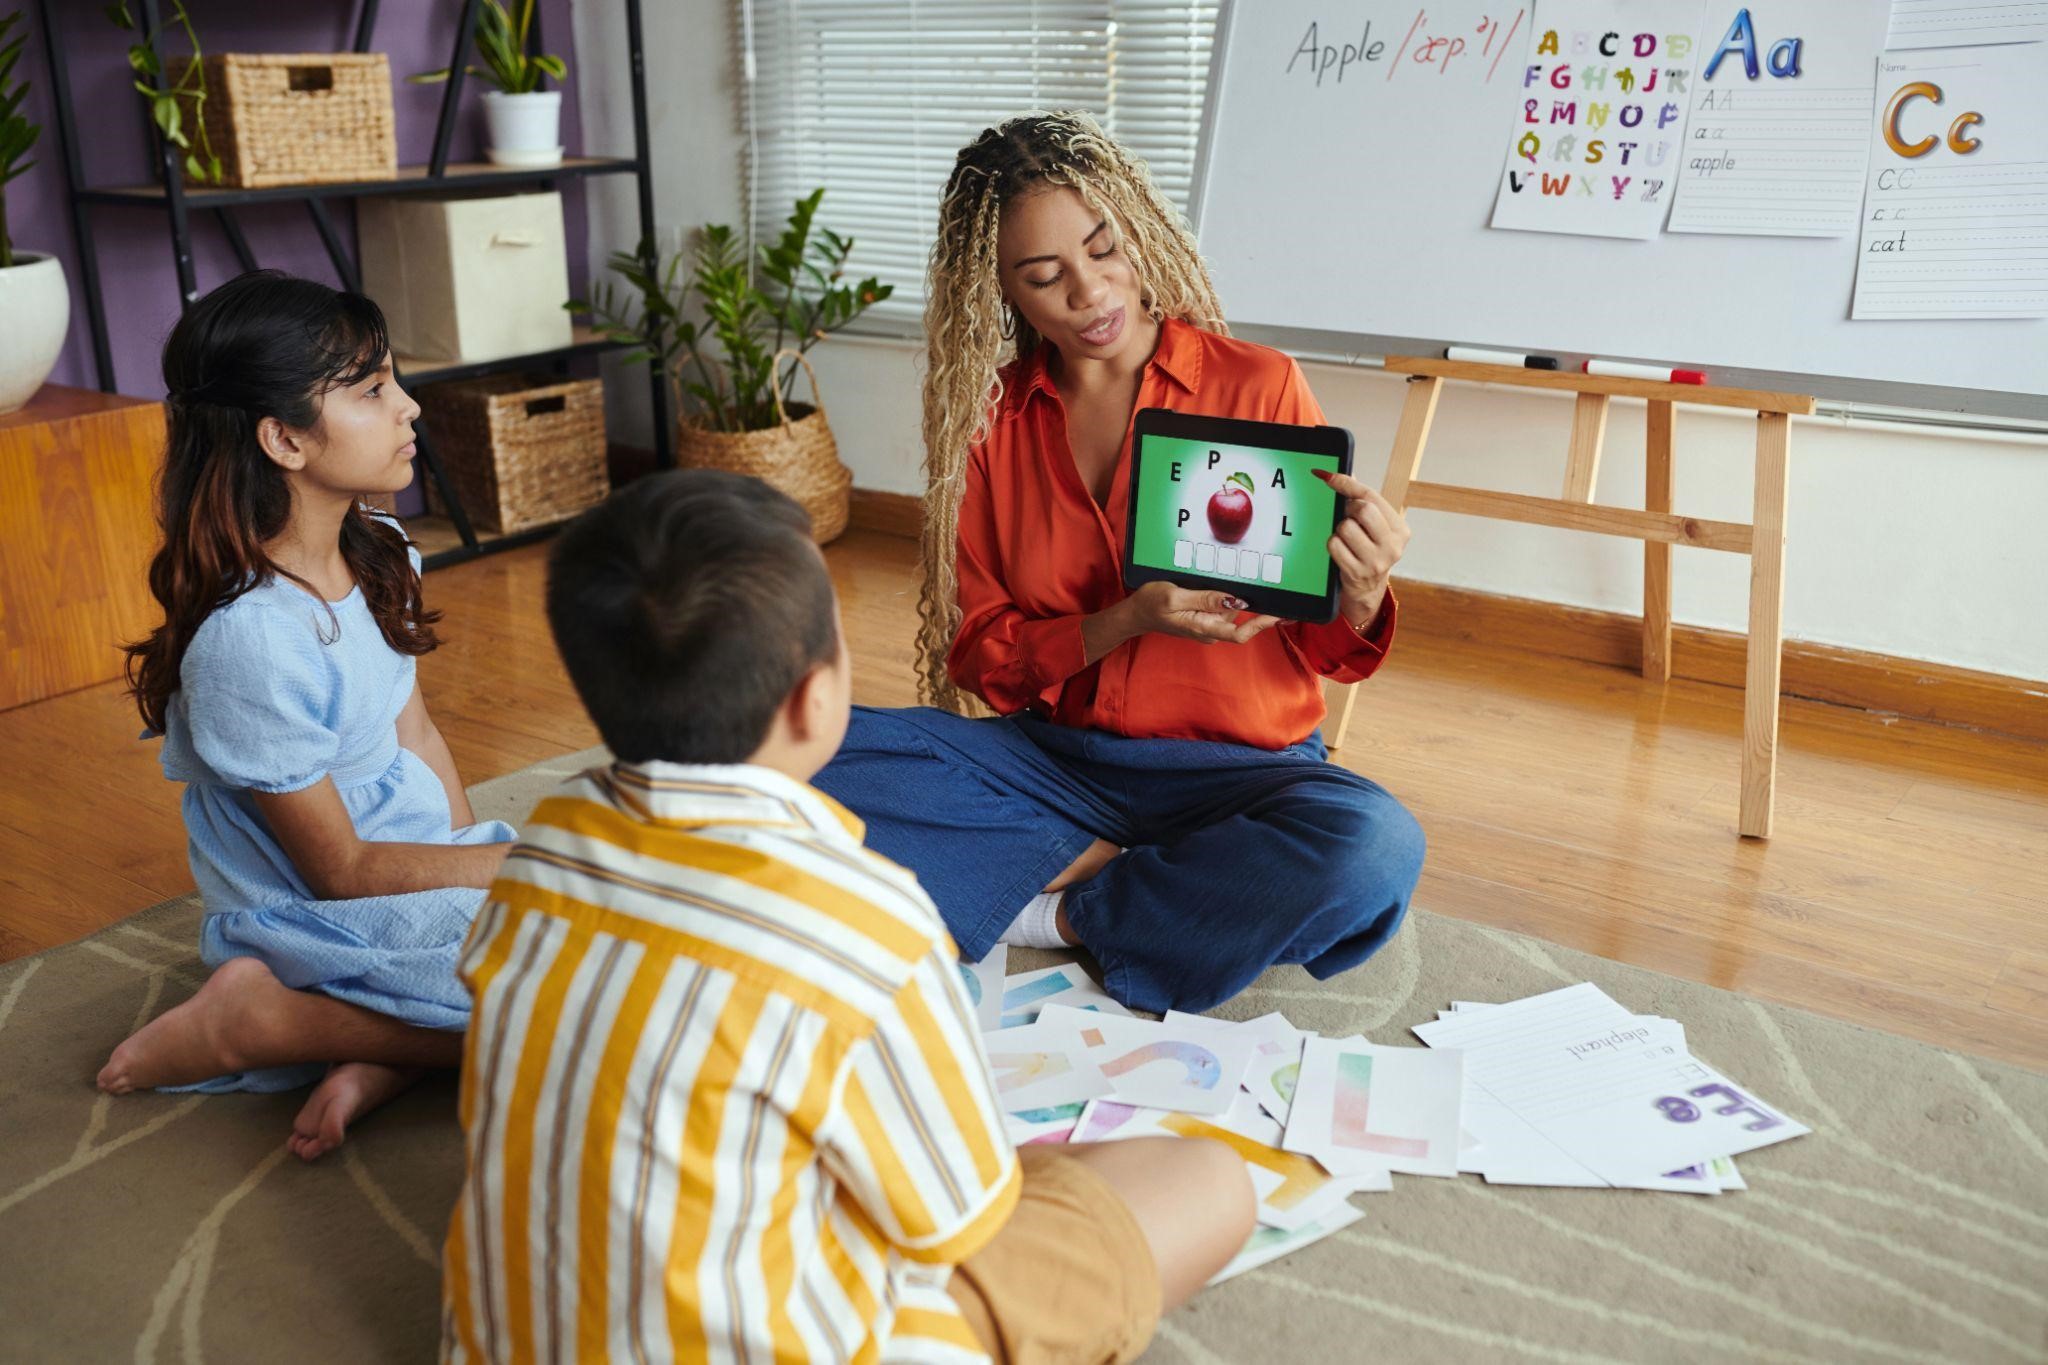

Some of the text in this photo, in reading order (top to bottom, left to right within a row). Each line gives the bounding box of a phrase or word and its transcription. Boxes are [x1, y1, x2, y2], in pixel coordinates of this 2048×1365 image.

[1286, 19, 1386, 88] Apple
[1537, 30, 1559, 55] A
[1599, 31, 1619, 56] C
[1633, 33, 1657, 57] D
[1665, 34, 1692, 58] E
[1703, 8, 1803, 81] Aa
[1524, 65, 1542, 88] F
[1551, 64, 1571, 89] G
[1550, 101, 1576, 125] M
[1586, 101, 1612, 129] N
[1619, 105, 1643, 128] O
[1518, 131, 1541, 164] Q
[1553, 133, 1578, 162] R
[1584, 139, 1607, 164] S
[1618, 142, 1638, 165] T
[1690, 149, 1735, 176] apple
[1542, 173, 1571, 196] W
[1867, 229, 1906, 252] cat
[1170, 462, 1182, 482] E
[1207, 450, 1221, 470] P
[1271, 468, 1286, 489] A
[1177, 508, 1191, 528] P
[1281, 515, 1293, 537] L
[1565, 1026, 1650, 1062] elephant
